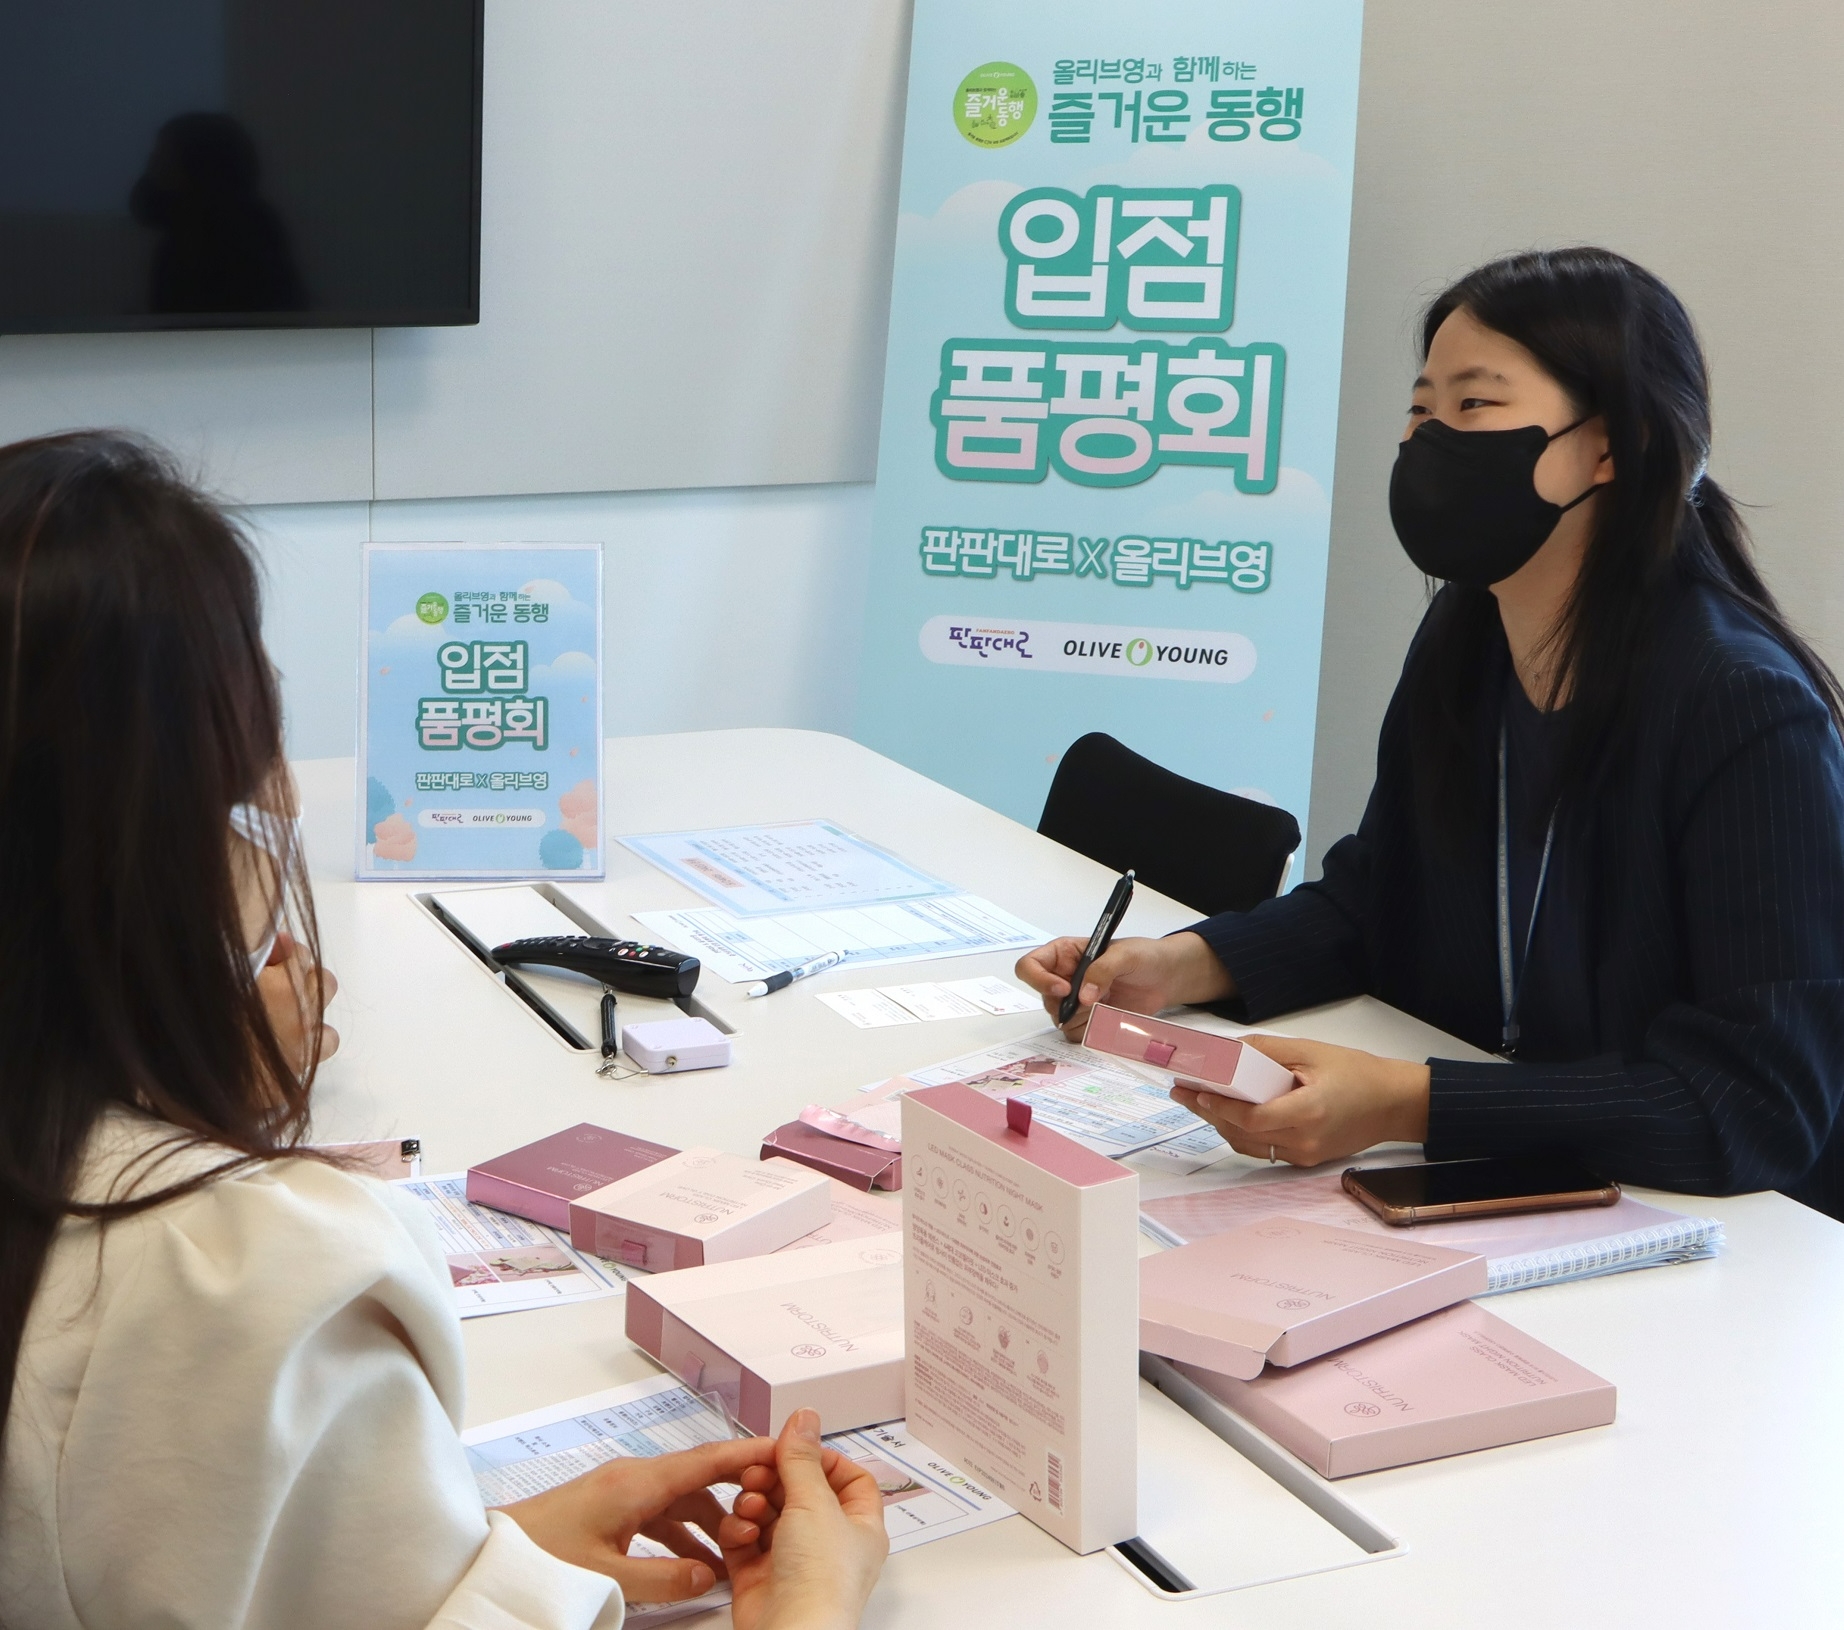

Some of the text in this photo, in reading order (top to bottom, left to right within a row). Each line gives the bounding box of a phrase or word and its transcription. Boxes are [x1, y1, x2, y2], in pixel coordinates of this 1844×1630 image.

[1053, 56, 1257, 84] 올리브영과 함께하는
[1047, 87, 1304, 144] 즐거운 동행
[1004, 190, 1235, 325] 입점
[935, 342, 1279, 488] 품평회
[922, 528, 1071, 579] 판판대로
[1114, 536, 1270, 590] 올리브영
[454, 592, 496, 602] 올리브영과
[453, 604, 508, 624] 즐거운
[513, 603, 549, 623] 동행
[1063, 639, 1229, 666] OLIVE YOUNG
[439, 642, 526, 692] 입점
[418, 697, 546, 749] 품평회
[416, 773, 474, 790] 판판대로
[490, 772, 548, 791] 올리브영
[544, 1166, 605, 1185] NUTRISTORM
[927, 1142, 938, 1155] LED
[939, 1148, 955, 1164] MASK
[974, 1168, 1005, 1192] NUTRITION
[1006, 1185, 1024, 1202] NIGHT
[1025, 1196, 1042, 1213] MASK
[656, 1191, 736, 1215] NUTRISTORM
[610, 1267, 628, 1281] YOUNG
[1226, 1272, 1339, 1300] NUTRISTORM
[781, 1302, 858, 1353] NUTRISTORM
[1454, 1330, 1549, 1384] NUTRITION NIGHT MASK
[1491, 1361, 1522, 1376] MASK
[1319, 1357, 1418, 1411] NUTRISTORM
[1515, 1376, 1538, 1386] LED
[873, 1427, 906, 1449] 기술서
[927, 1461, 953, 1477] OLIVE
[961, 1481, 992, 1501] YOUNG
